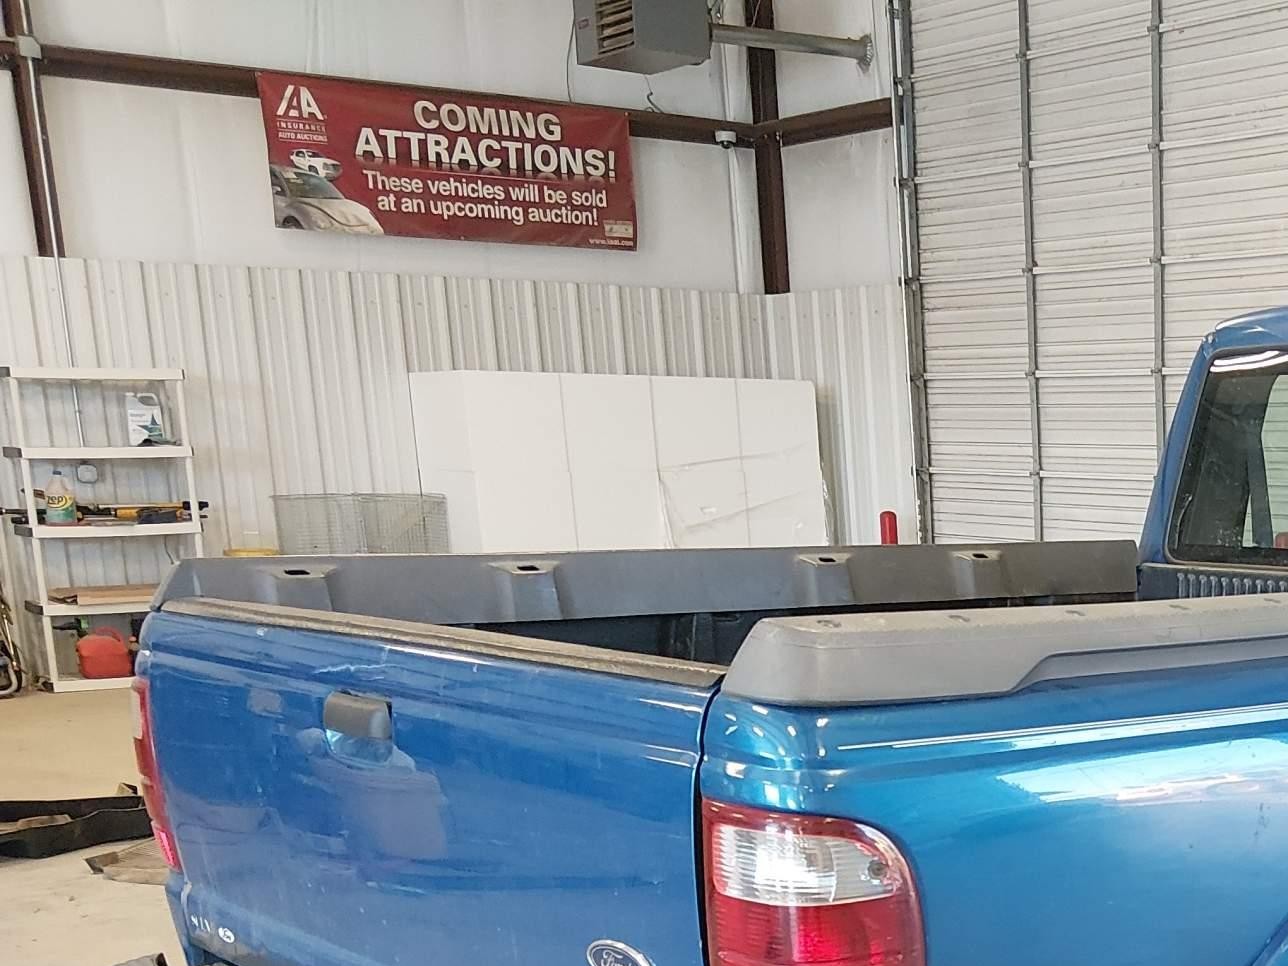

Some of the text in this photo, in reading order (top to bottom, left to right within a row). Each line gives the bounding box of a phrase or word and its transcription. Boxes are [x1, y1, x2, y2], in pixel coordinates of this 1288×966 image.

[278, 131, 296, 139] AUTO
[413, 99, 562, 141] COMING
[355, 127, 616, 178] ATTRACTIONS!
[362, 169, 608, 209] These vehicles will be sold
[377, 193, 600, 227] at an upcoming auction!
